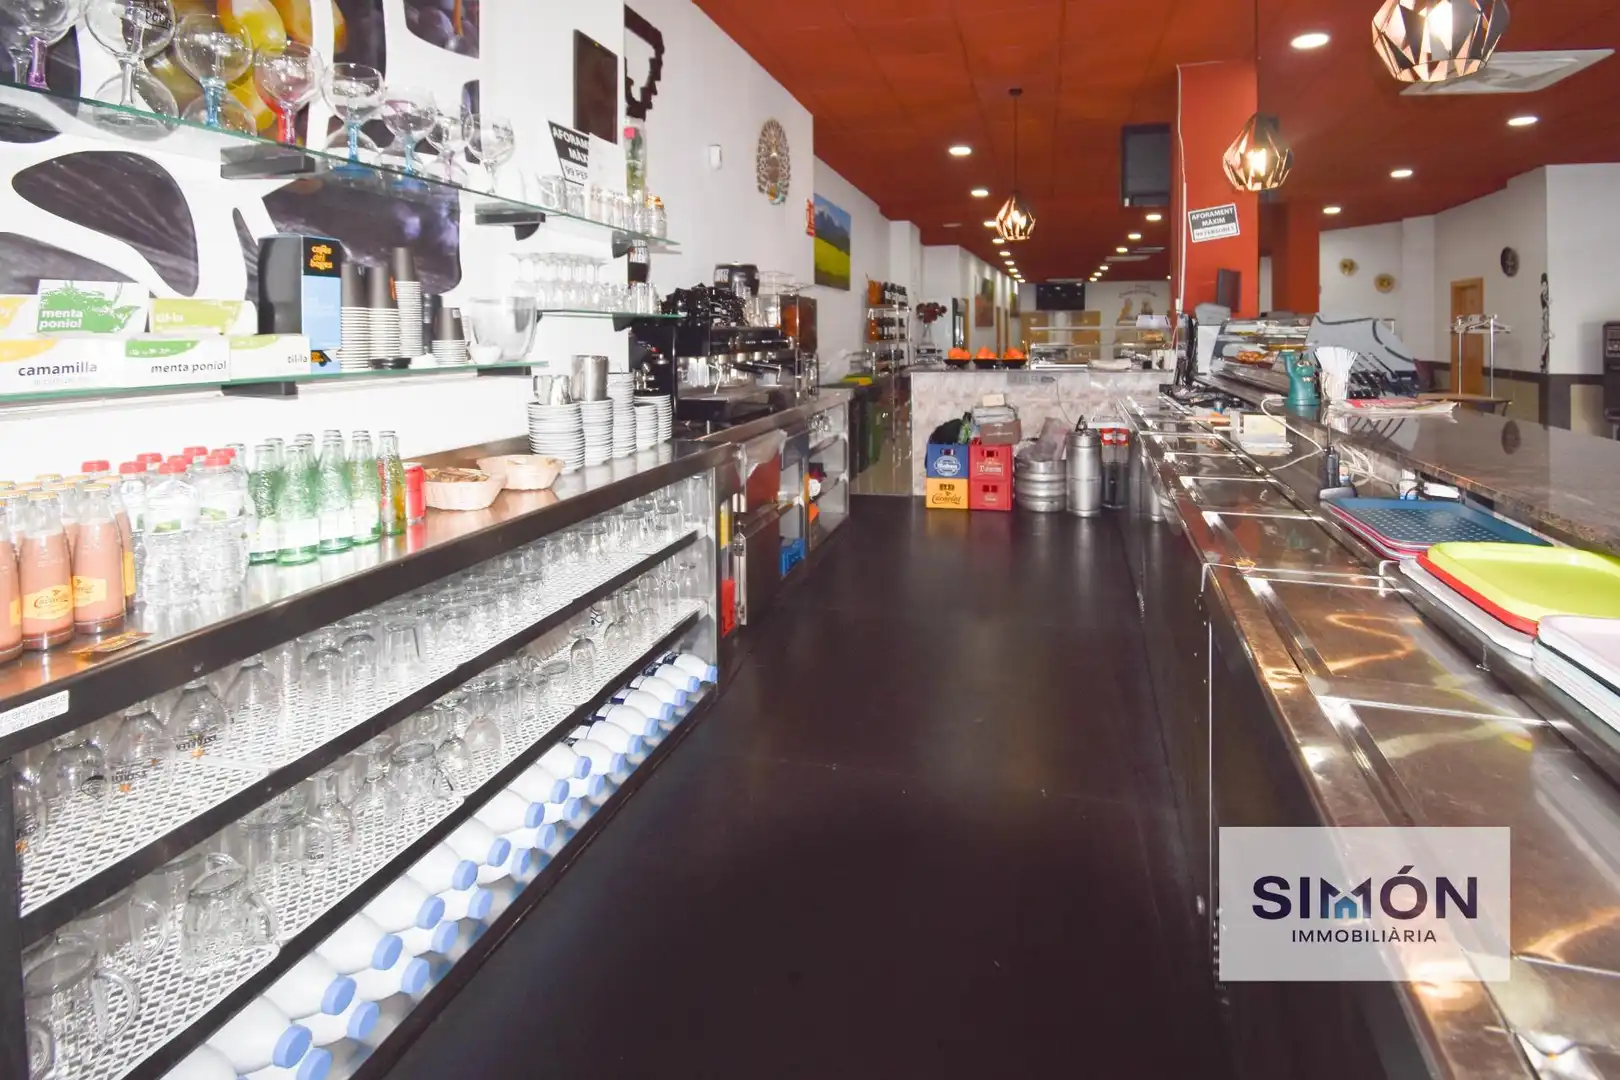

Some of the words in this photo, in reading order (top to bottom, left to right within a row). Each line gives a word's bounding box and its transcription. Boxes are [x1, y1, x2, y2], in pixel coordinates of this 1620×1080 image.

[1191, 207, 1234, 220] AFORAMENT
[41, 309, 84, 319] menta
[38, 318, 82, 331] poniol
[18, 361, 98, 377] camamilla
[150, 362, 190, 374] menta
[192, 359, 227, 375] poniol
